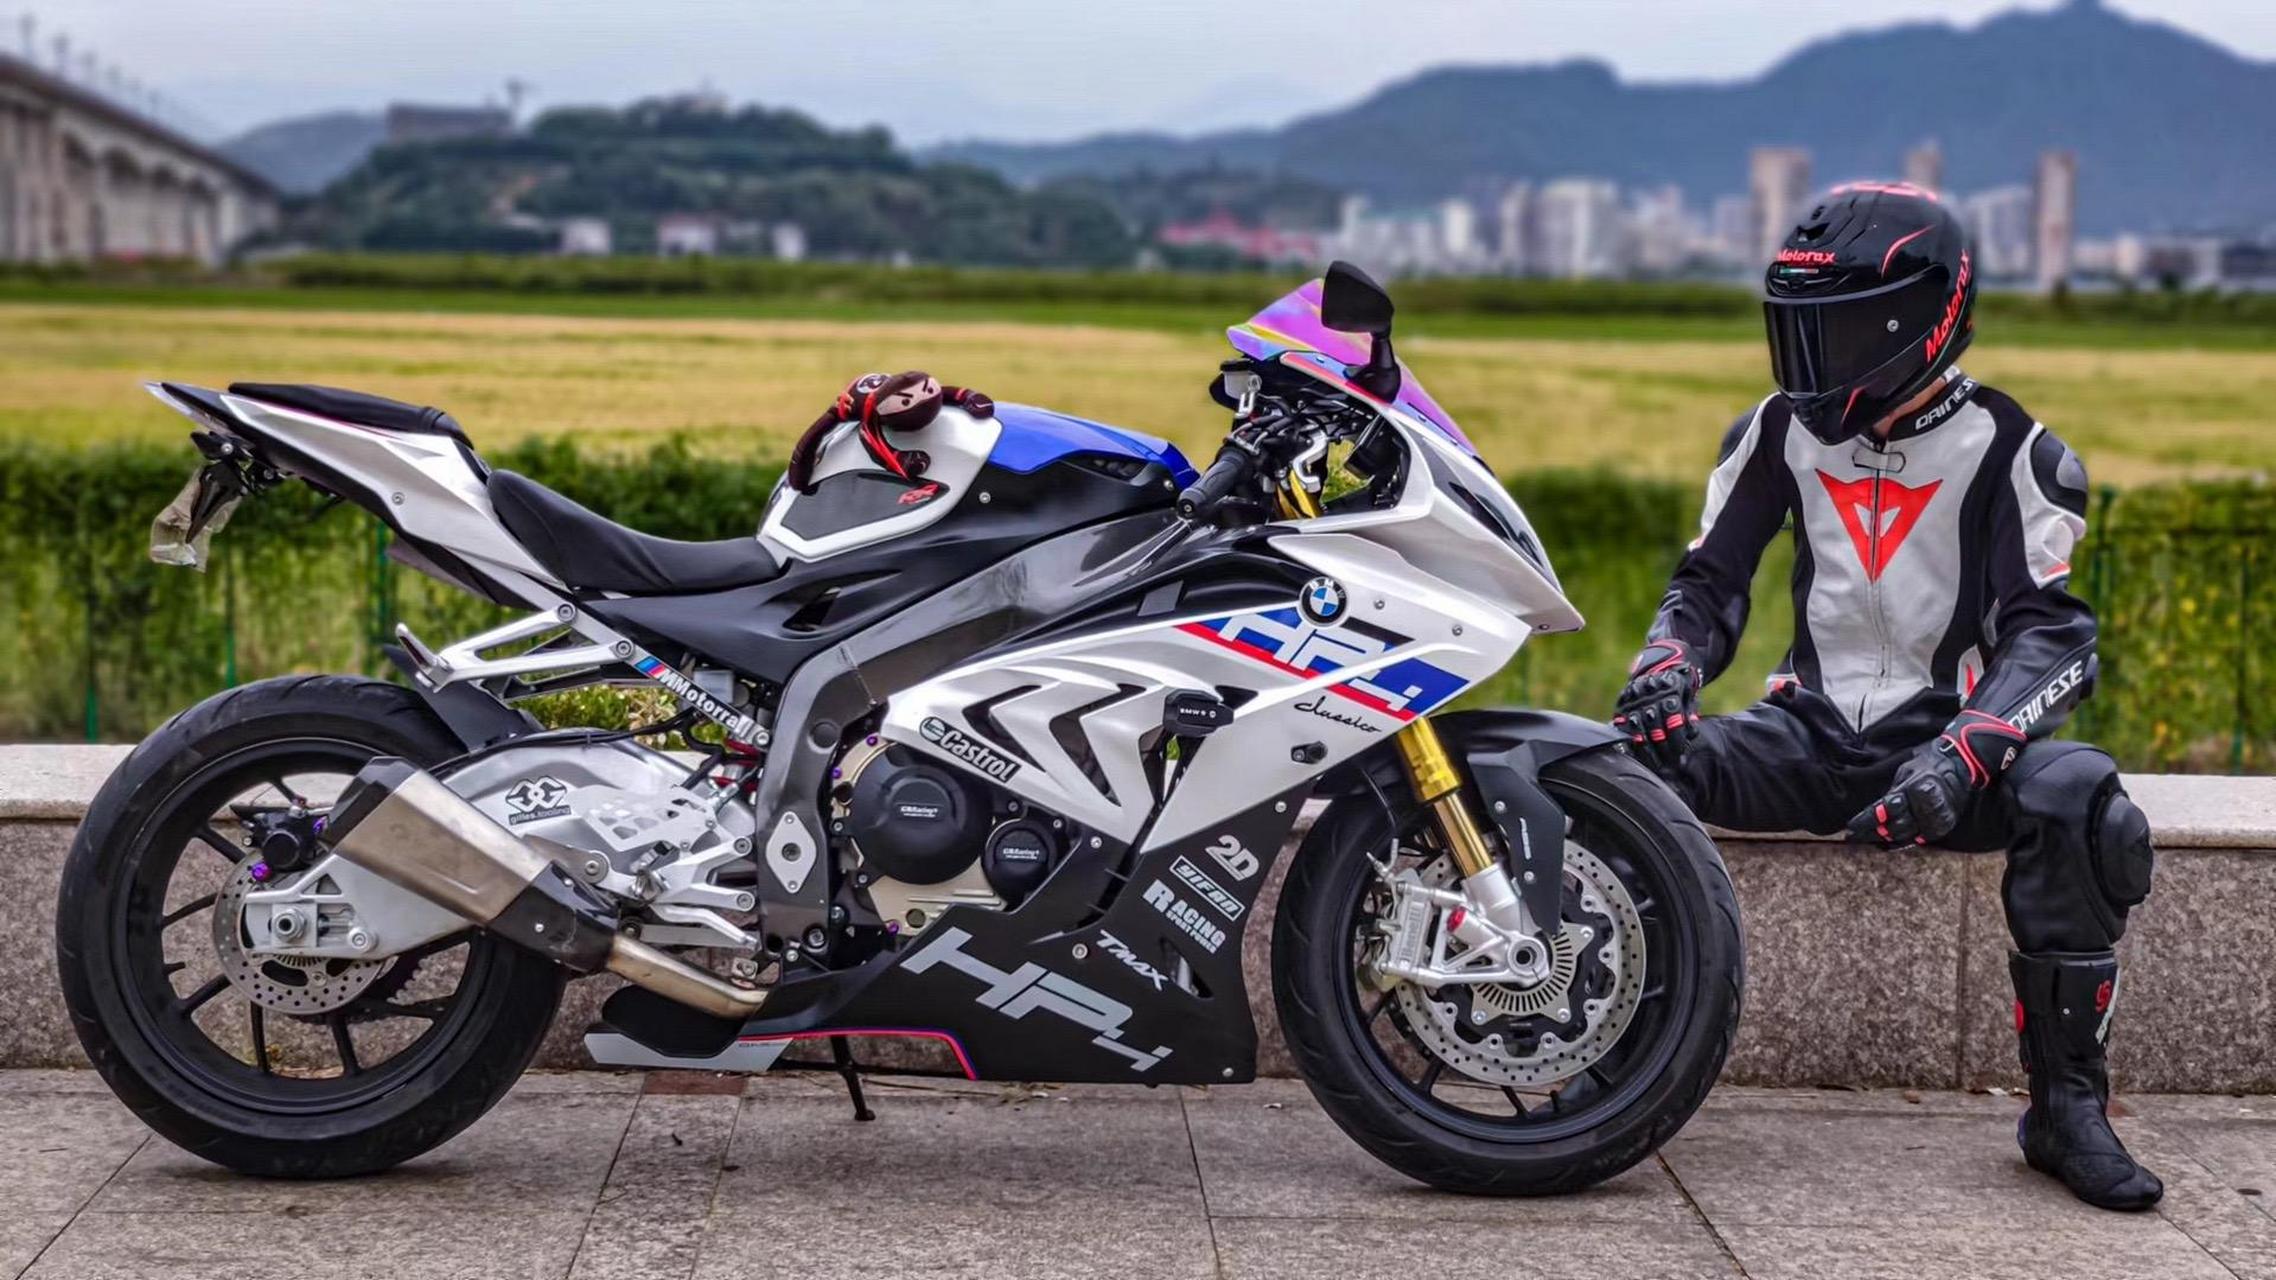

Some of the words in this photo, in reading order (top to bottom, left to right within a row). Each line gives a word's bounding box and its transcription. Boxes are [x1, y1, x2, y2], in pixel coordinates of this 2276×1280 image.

[940, 730, 1017, 781] Castrol
[1205, 834, 1259, 881] 2D
[1142, 879, 1226, 948] RACING
[1096, 929, 1169, 991] TMAX
[900, 926, 1173, 1072] HP4
